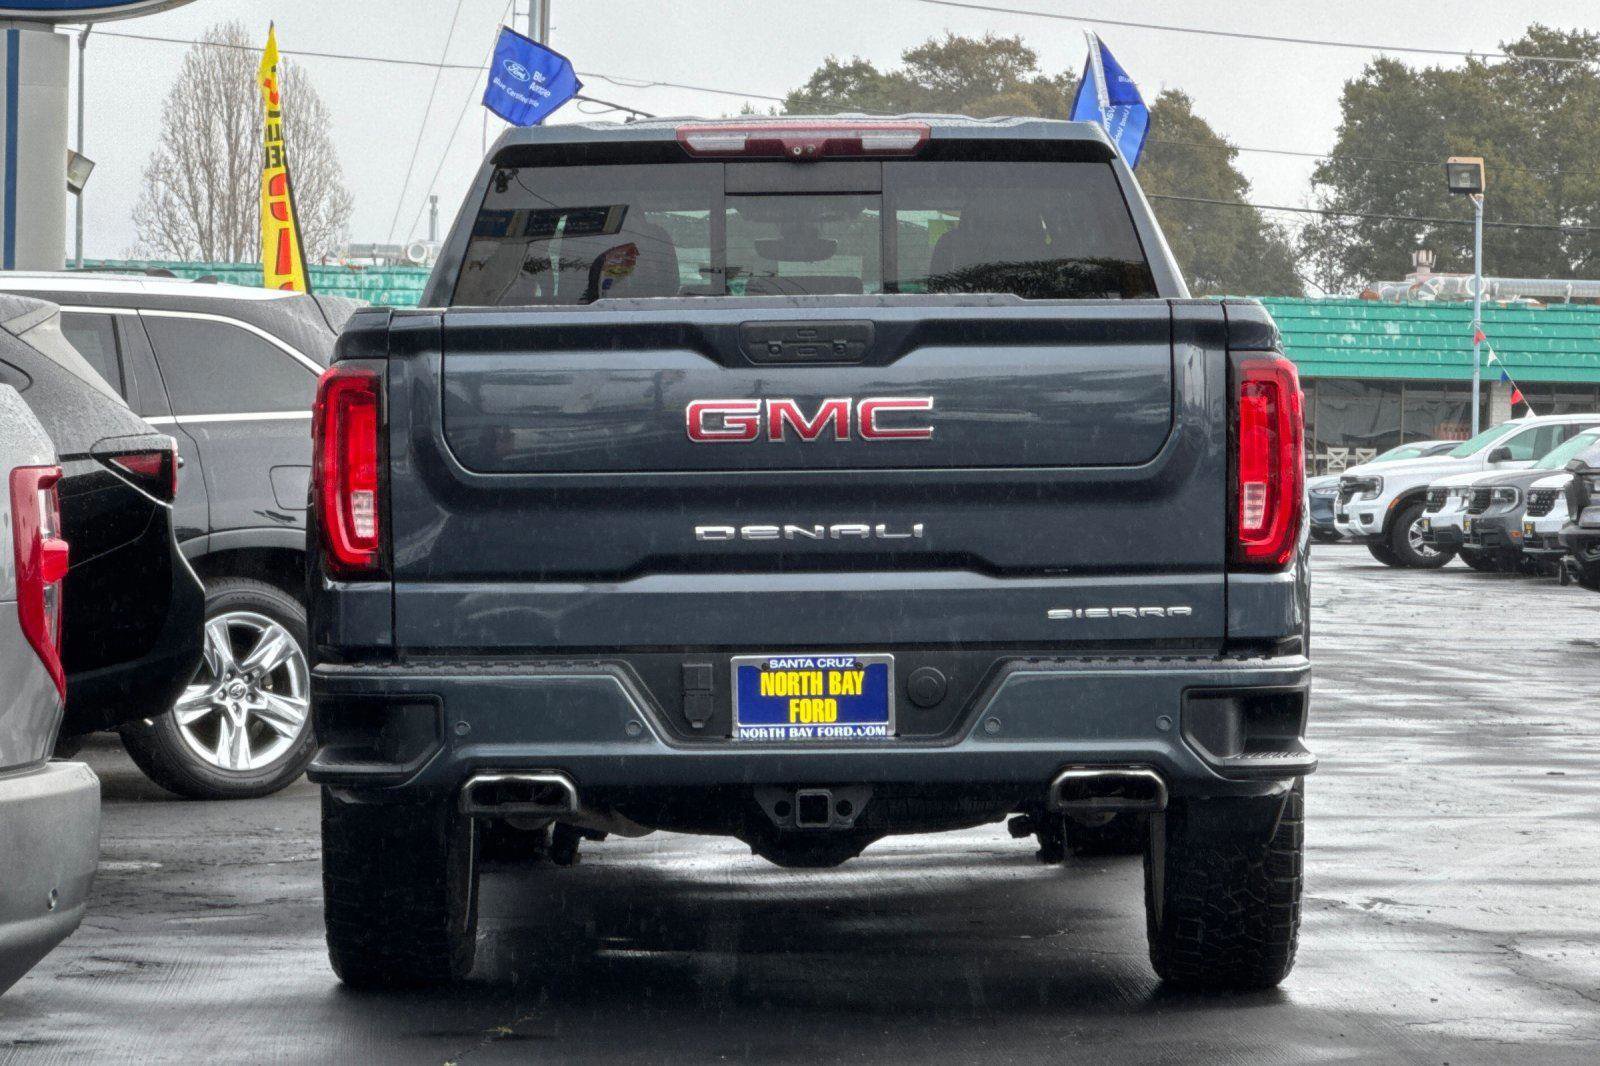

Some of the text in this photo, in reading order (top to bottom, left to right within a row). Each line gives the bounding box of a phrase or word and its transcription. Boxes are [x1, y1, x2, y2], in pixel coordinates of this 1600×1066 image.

[686, 396, 935, 443] GMC
[695, 523, 924, 540] DENALI
[1047, 606, 1192, 619] SIERRA
[769, 658, 855, 669] SANTA CRUZ
[760, 670, 865, 696] NORTH BAY
[789, 698, 837, 723] FORD
[740, 726, 886, 738] NORTH BAY FORD.COM
